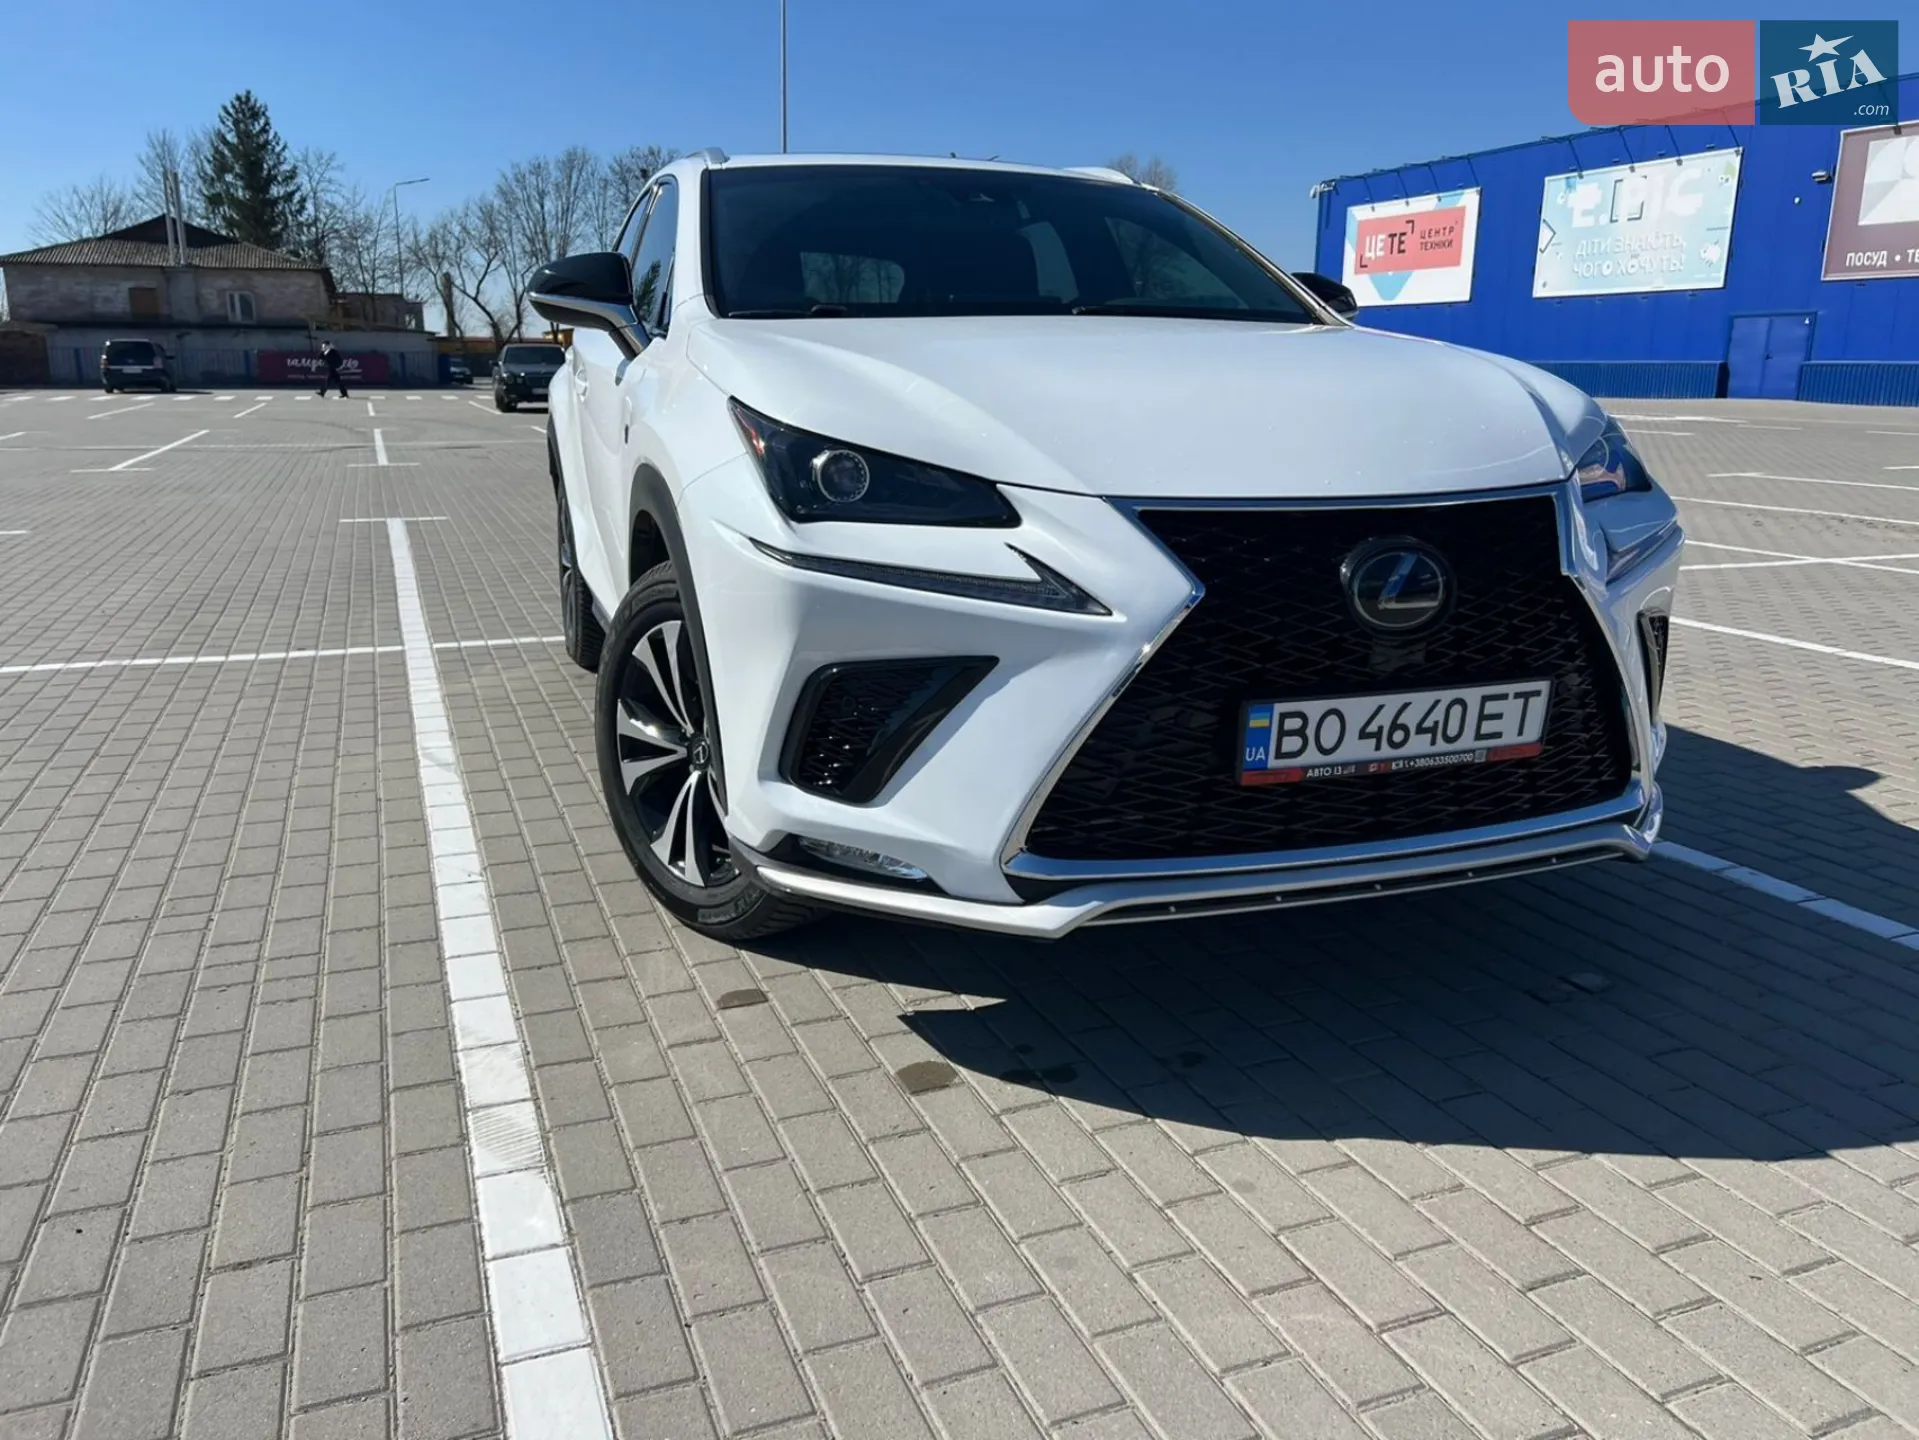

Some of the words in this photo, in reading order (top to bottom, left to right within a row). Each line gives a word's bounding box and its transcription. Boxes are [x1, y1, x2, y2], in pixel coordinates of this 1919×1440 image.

[1420, 226, 1455, 239] ЦЕНТР
[1575, 237, 1611, 257] ДІТИ
[1845, 250, 1888, 268] ПОСУД
[1572, 259, 1614, 279] ЧОГО
[1358, 697, 1468, 752] 4640
[1245, 746, 1266, 762] UA
